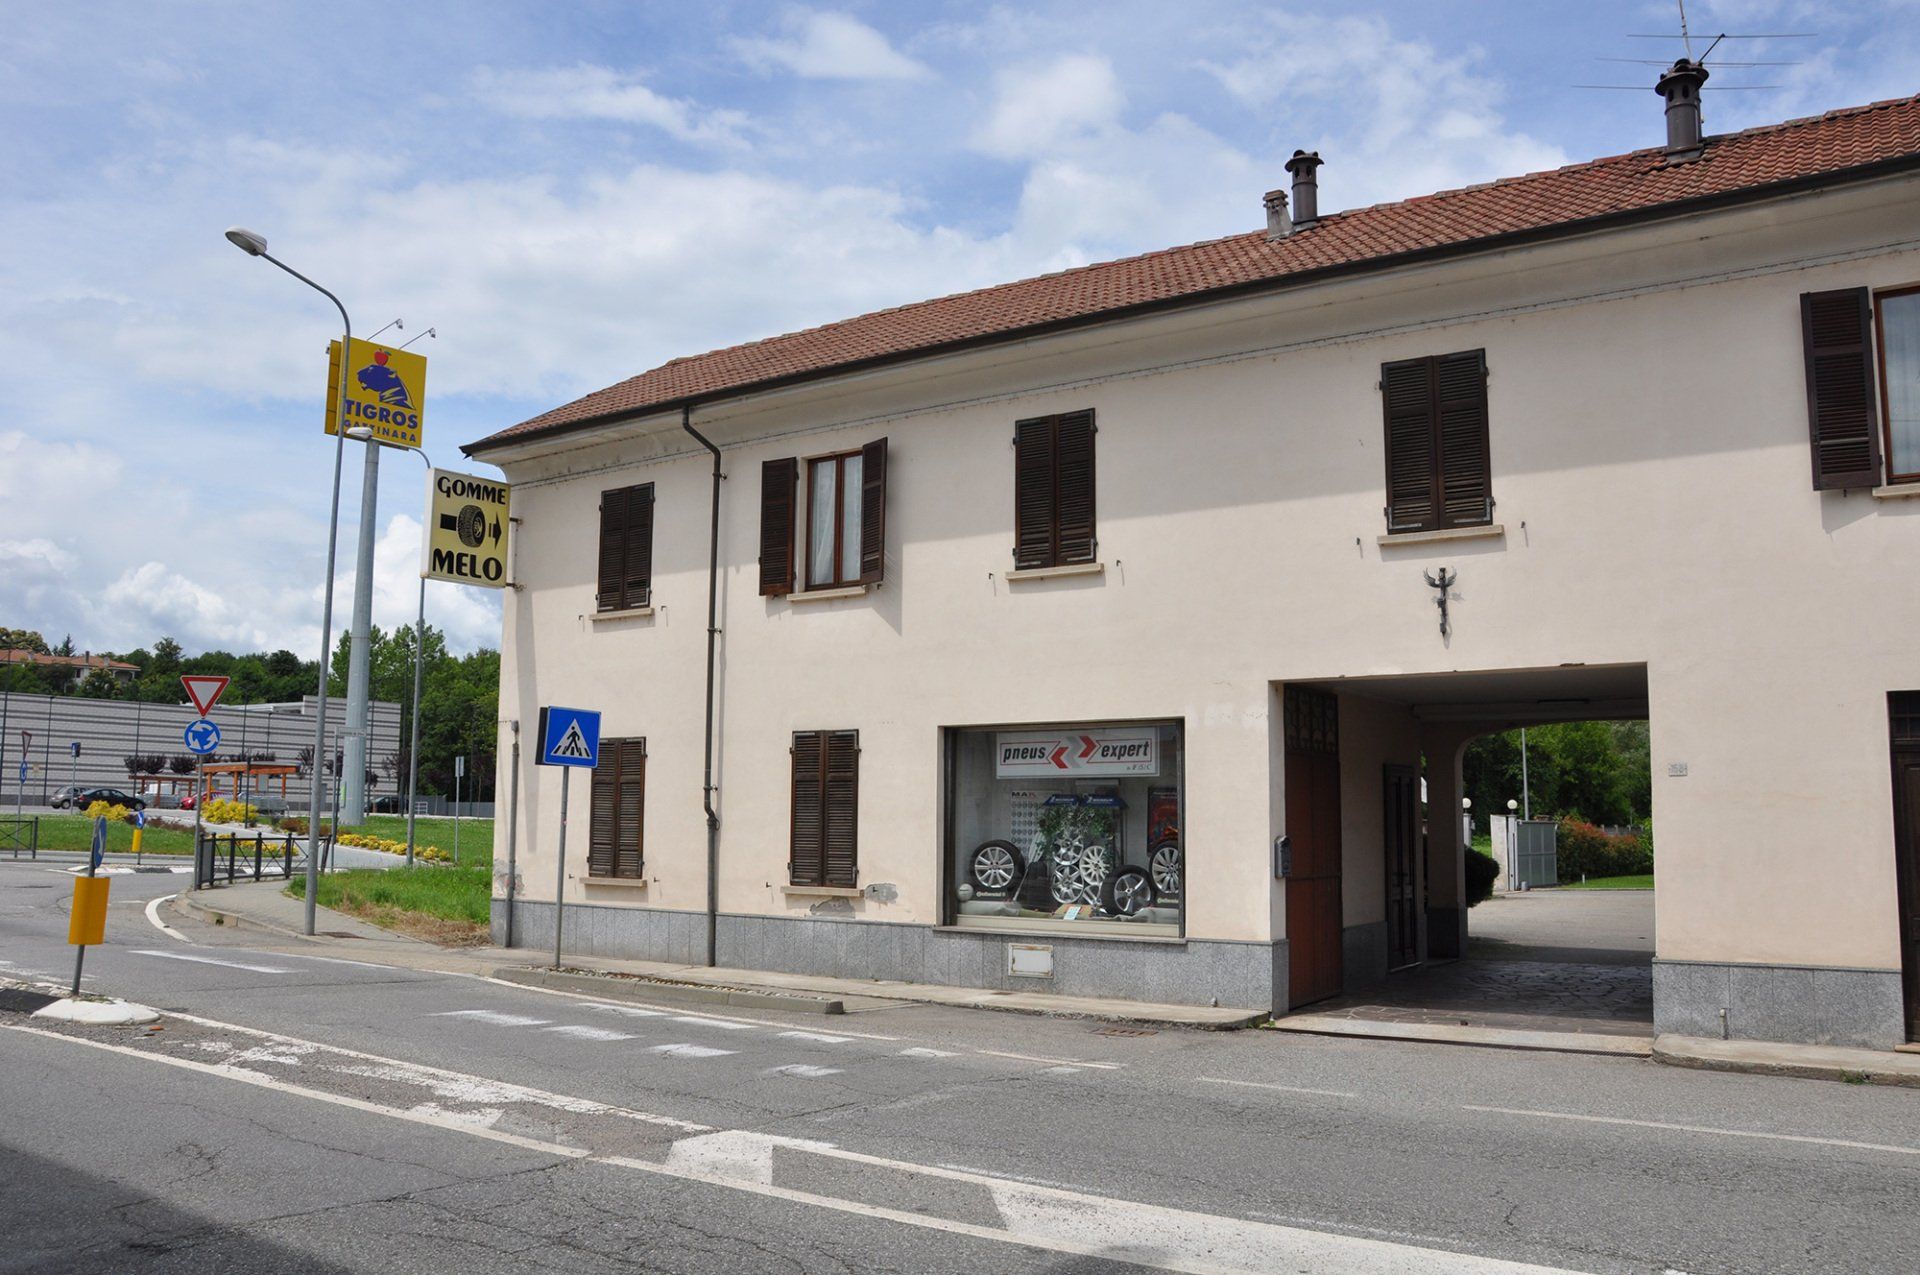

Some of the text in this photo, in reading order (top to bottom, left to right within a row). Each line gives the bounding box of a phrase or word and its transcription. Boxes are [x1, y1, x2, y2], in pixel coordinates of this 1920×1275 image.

[345, 399, 418, 429] TIGROS
[437, 476, 506, 505] GOMME
[432, 547, 503, 581] MELO
[1003, 740, 1150, 763] pneus expert
